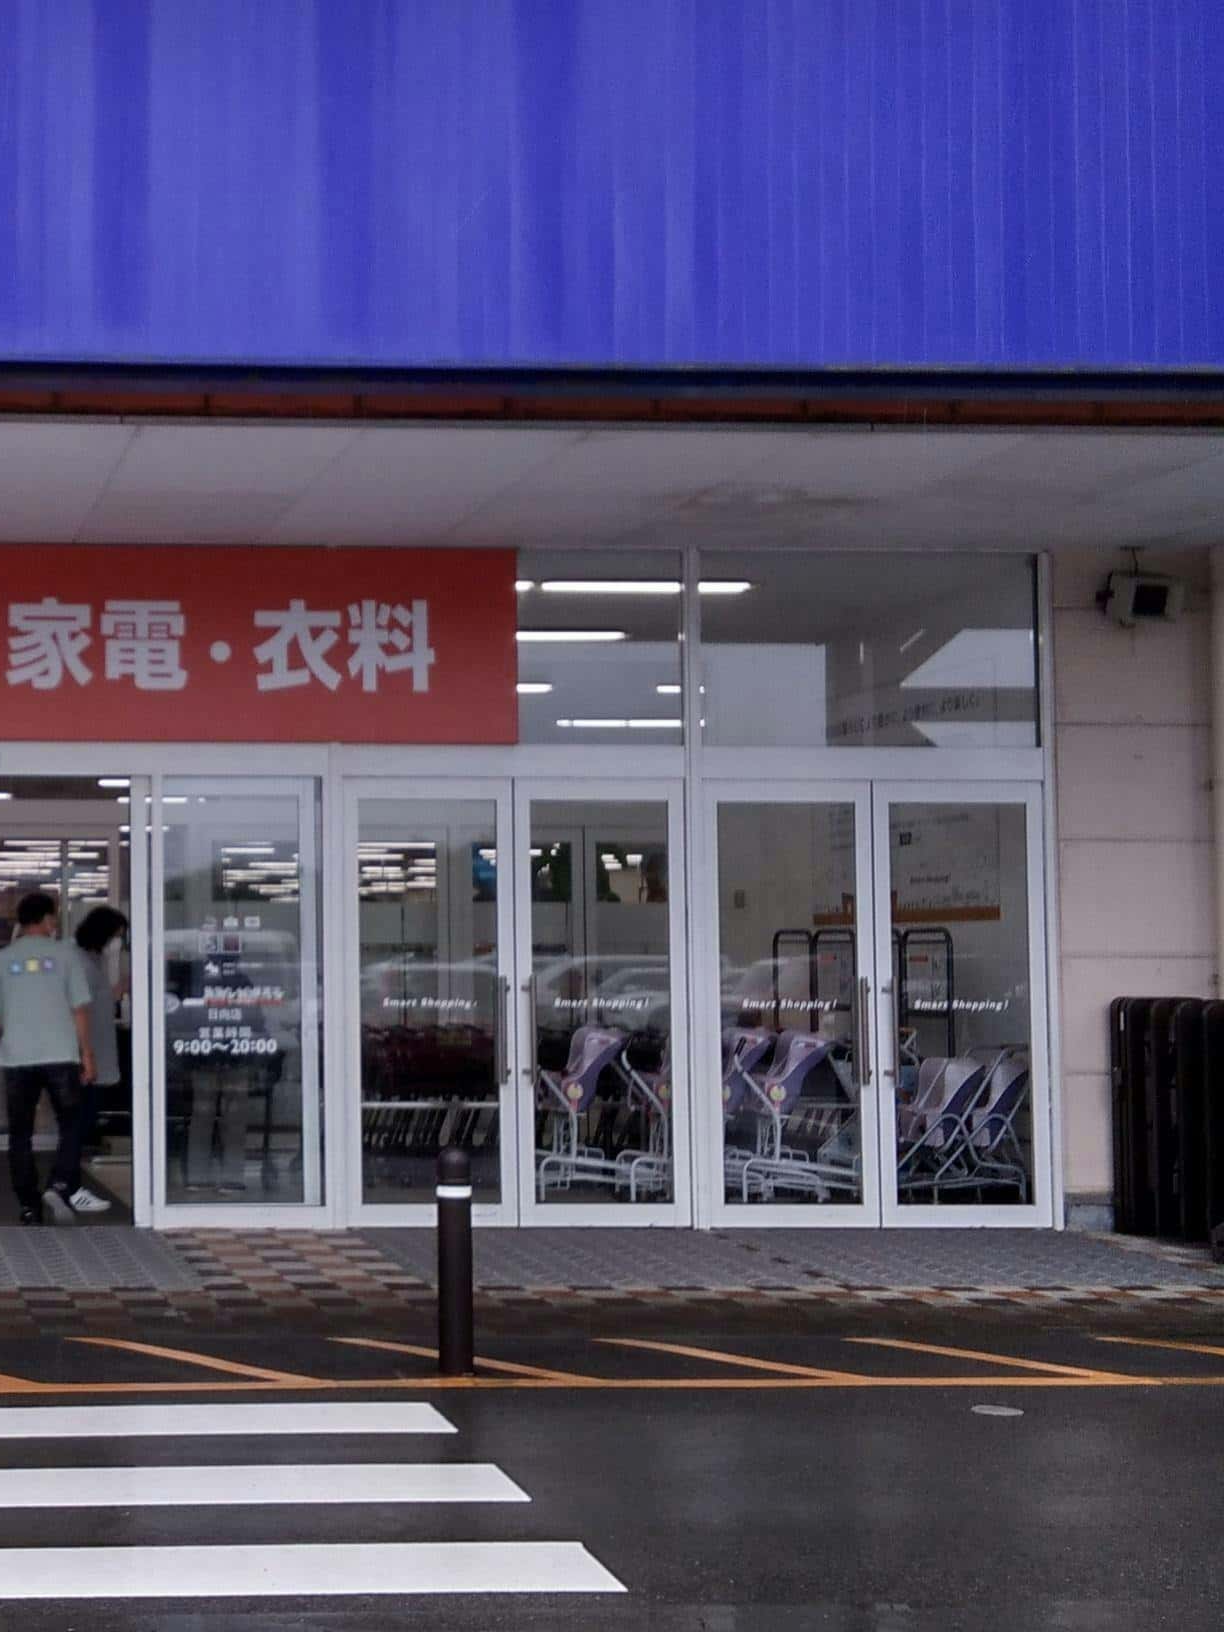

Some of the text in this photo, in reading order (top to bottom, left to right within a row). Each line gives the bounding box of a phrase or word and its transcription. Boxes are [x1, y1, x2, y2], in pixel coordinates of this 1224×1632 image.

[553, 997, 588, 1009] Smart
[741, 998, 776, 1010] Smart
[913, 999, 948, 1011] Smart
